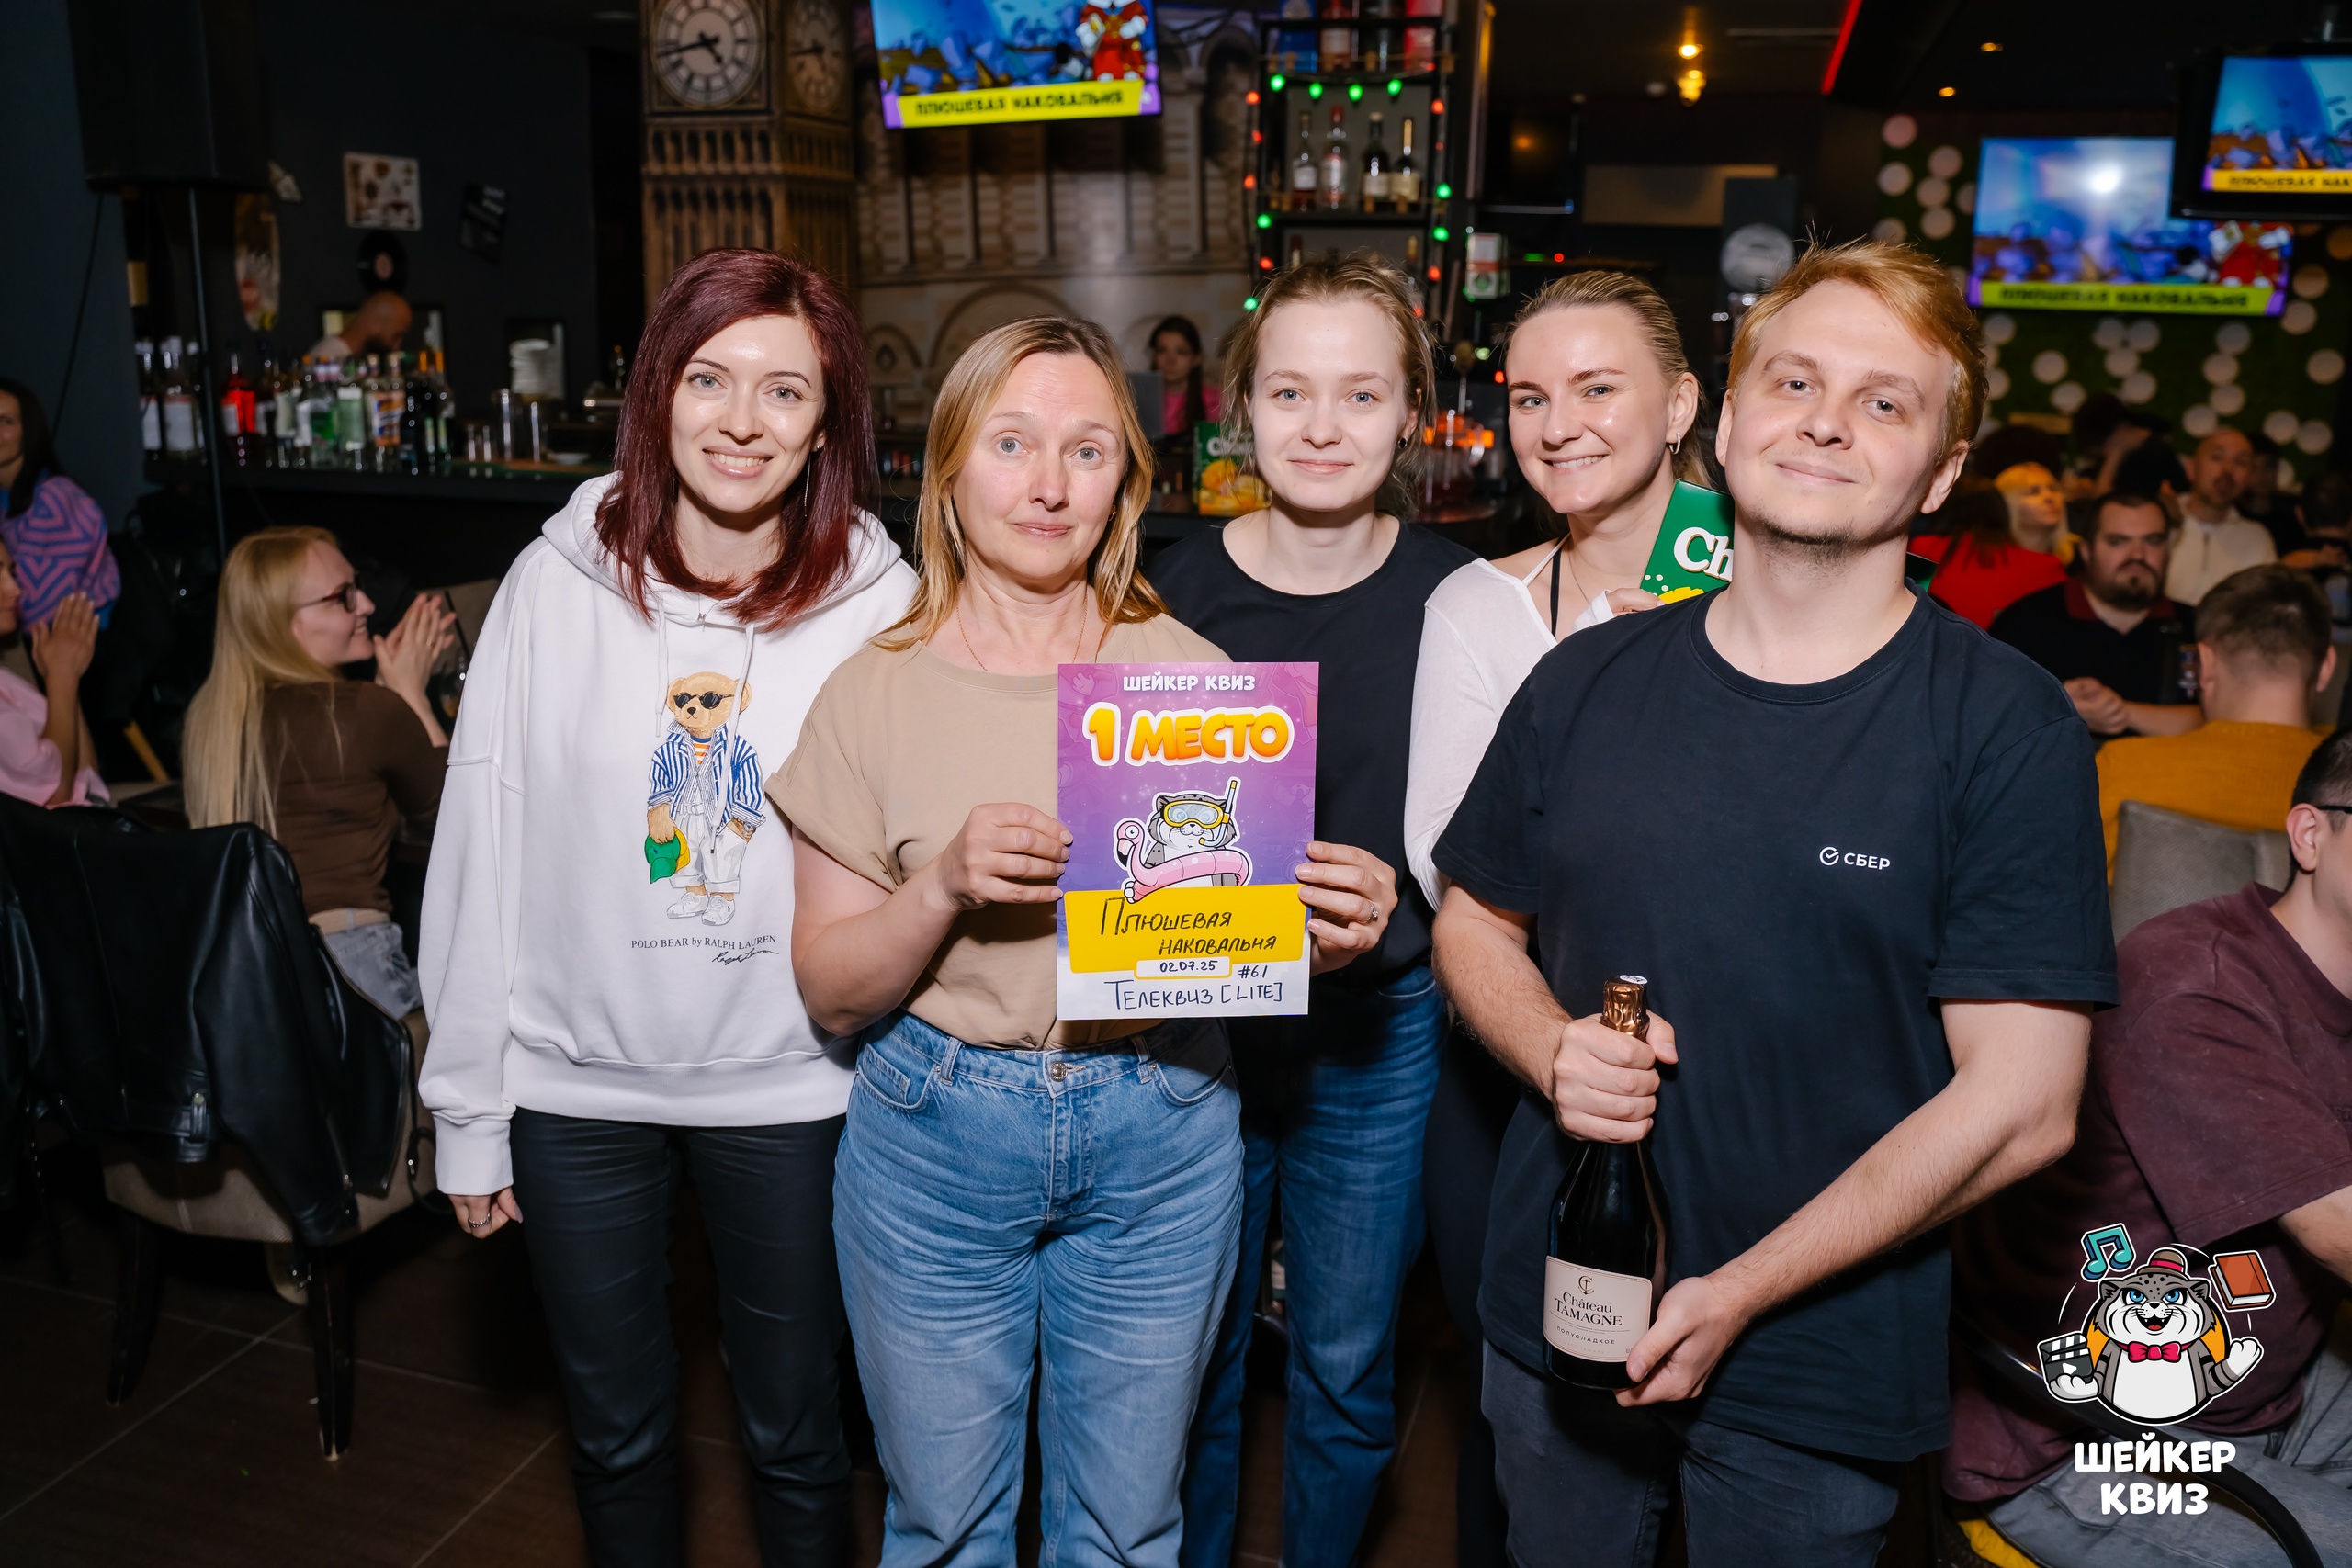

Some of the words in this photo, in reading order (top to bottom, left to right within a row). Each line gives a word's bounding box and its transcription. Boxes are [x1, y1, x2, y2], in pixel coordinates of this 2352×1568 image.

[1123, 671, 1198, 691] ШЕЙКЕР
[1205, 675, 1256, 690] КВИЗ
[1089, 708, 1114, 761] 1
[1131, 712, 1289, 760] МЕСТО
[1843, 852, 1891, 870] СБЕР
[631, 940, 658, 948] POLO
[661, 938, 689, 948] BEAR
[691, 937, 702, 947] by
[705, 938, 735, 950] RALPH
[739, 935, 776, 950] LAUREN
[1221, 982, 1283, 1004] [LITE]
[1555, 1298, 1623, 1326] TAMAGNE
[1563, 1292, 1612, 1314] Château
[1556, 1325, 1615, 1345] ПОЛУСЛАДКОЕ
